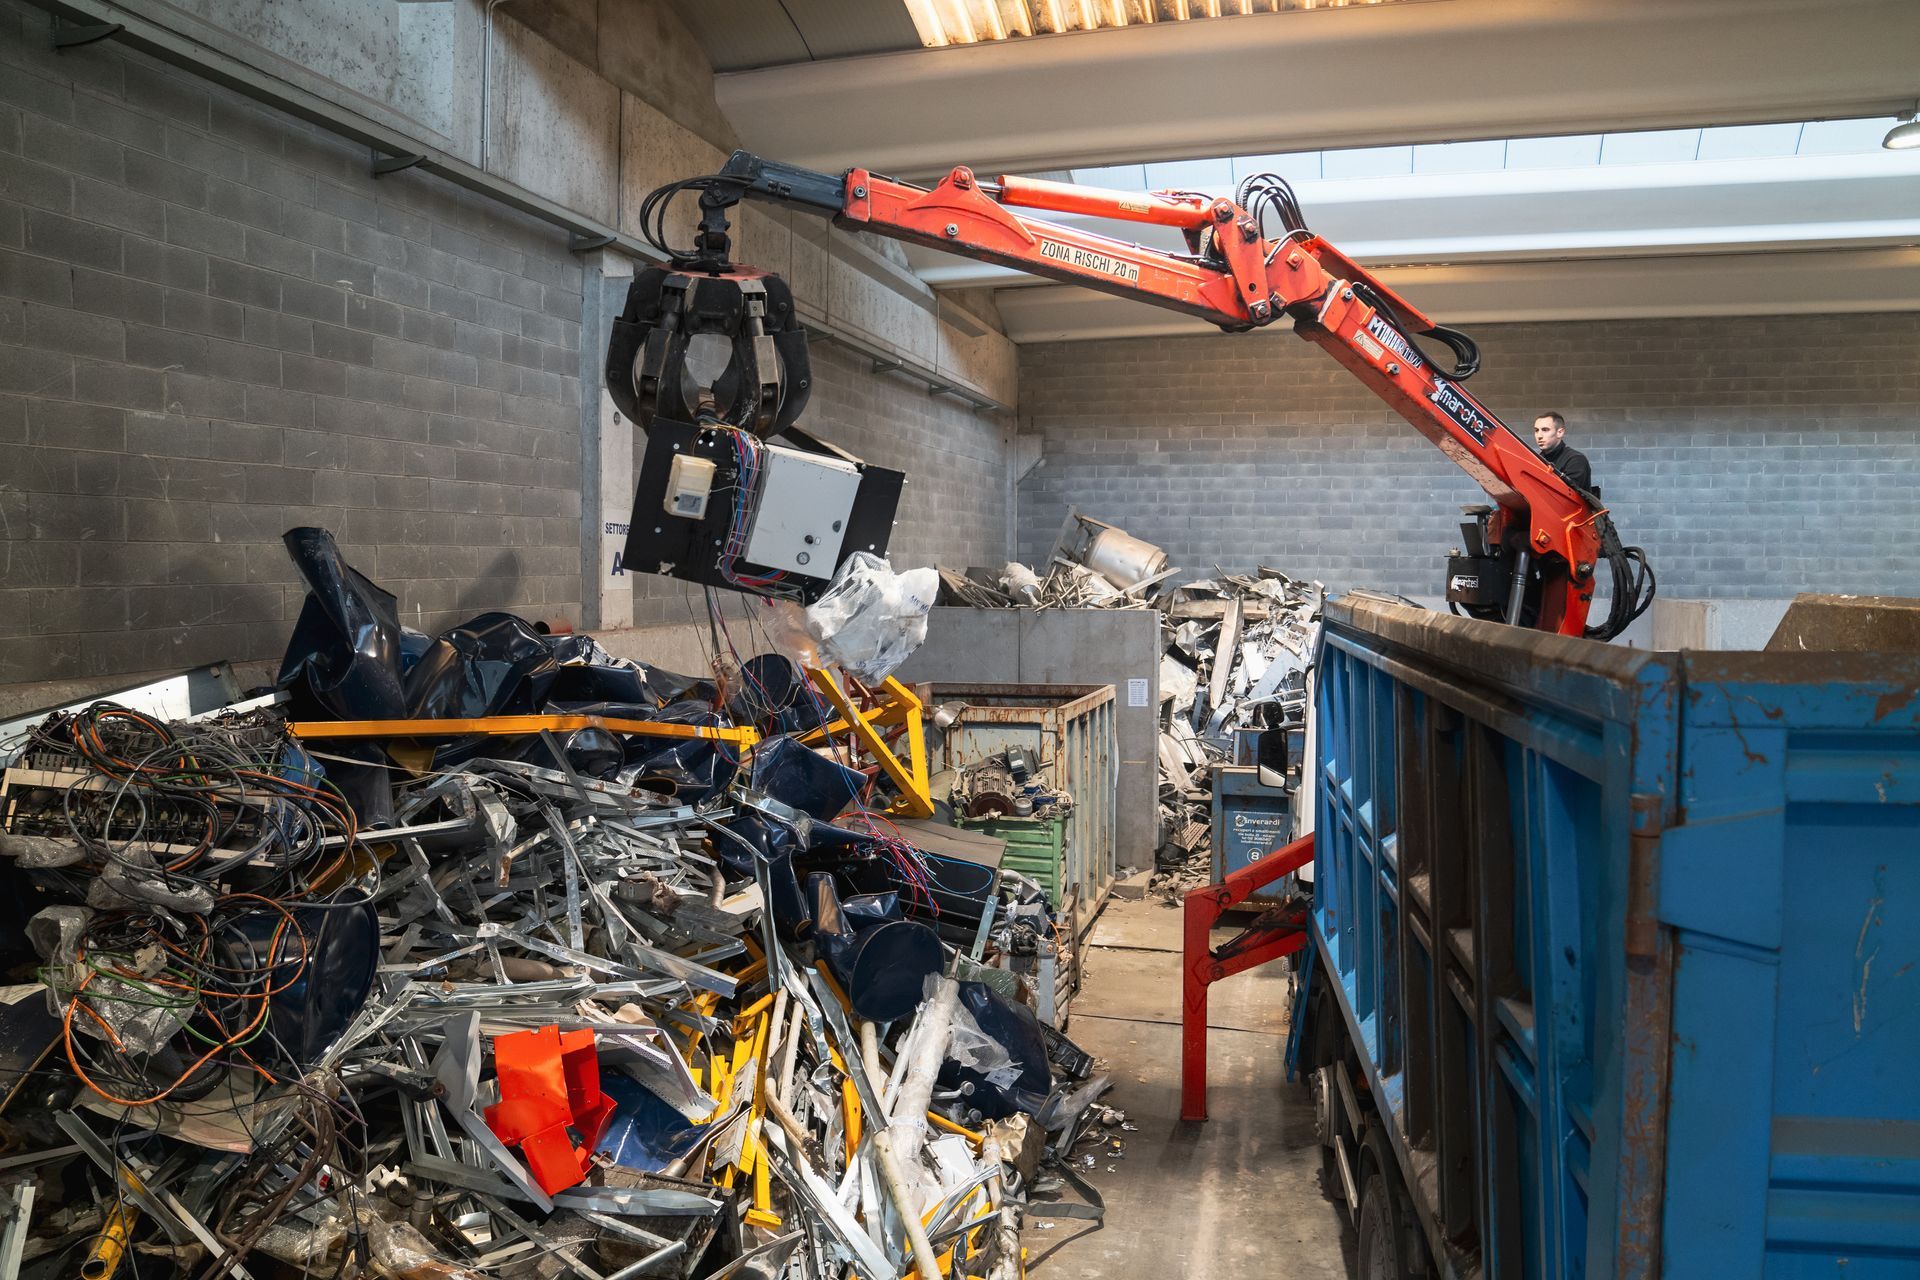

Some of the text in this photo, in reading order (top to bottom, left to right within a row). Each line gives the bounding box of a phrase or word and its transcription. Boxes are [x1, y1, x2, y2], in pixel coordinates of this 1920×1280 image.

[1041, 241, 1138, 280] ZONA RISCHI 20 m
[611, 551, 624, 576] A
[1251, 851, 1260, 860] 8
